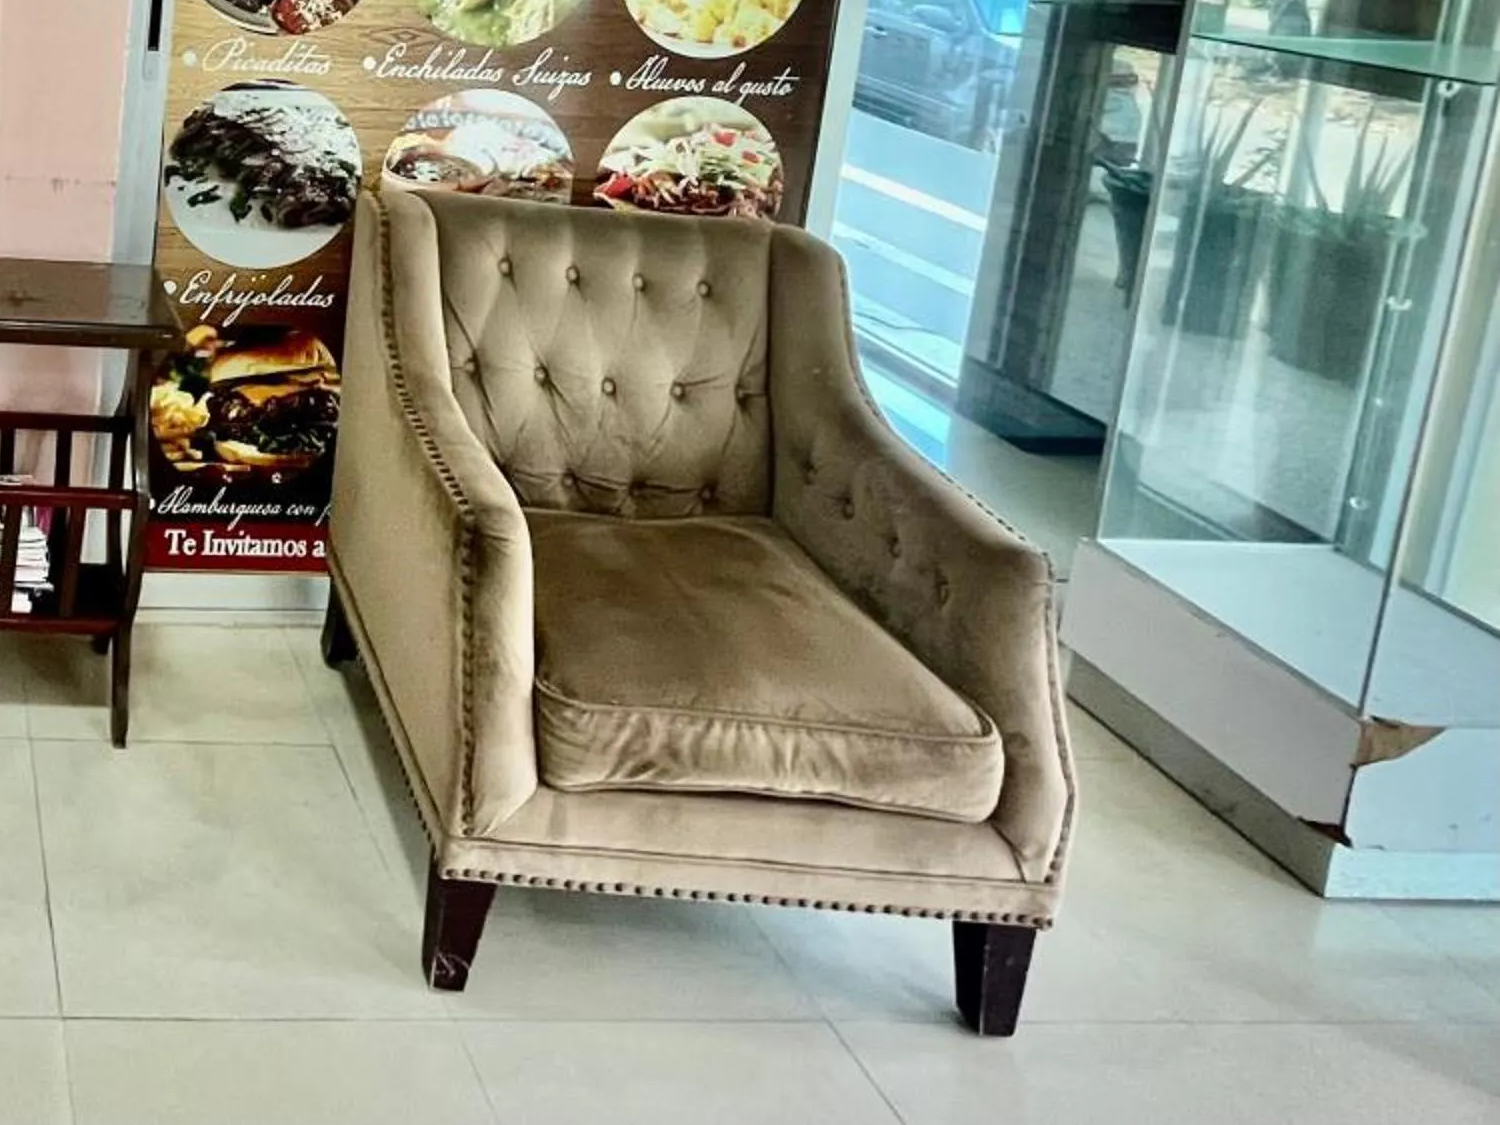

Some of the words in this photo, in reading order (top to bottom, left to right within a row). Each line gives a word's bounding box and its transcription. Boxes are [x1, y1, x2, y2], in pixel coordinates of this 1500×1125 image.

[202, 37, 333, 75] Picaditas
[373, 42, 503, 83] Enchiladas
[512, 46, 592, 101] Suizas
[625, 53, 707, 94] Huevos
[711, 60, 747, 94] al
[733, 66, 800, 107] gusto
[179, 269, 337, 328] Enfrijoladas
[157, 483, 283, 532] Hamburguesa
[285, 501, 316, 517] con
[164, 527, 197, 557] Te
[201, 529, 308, 558] Invitamos
[312, 539, 327, 558] a
